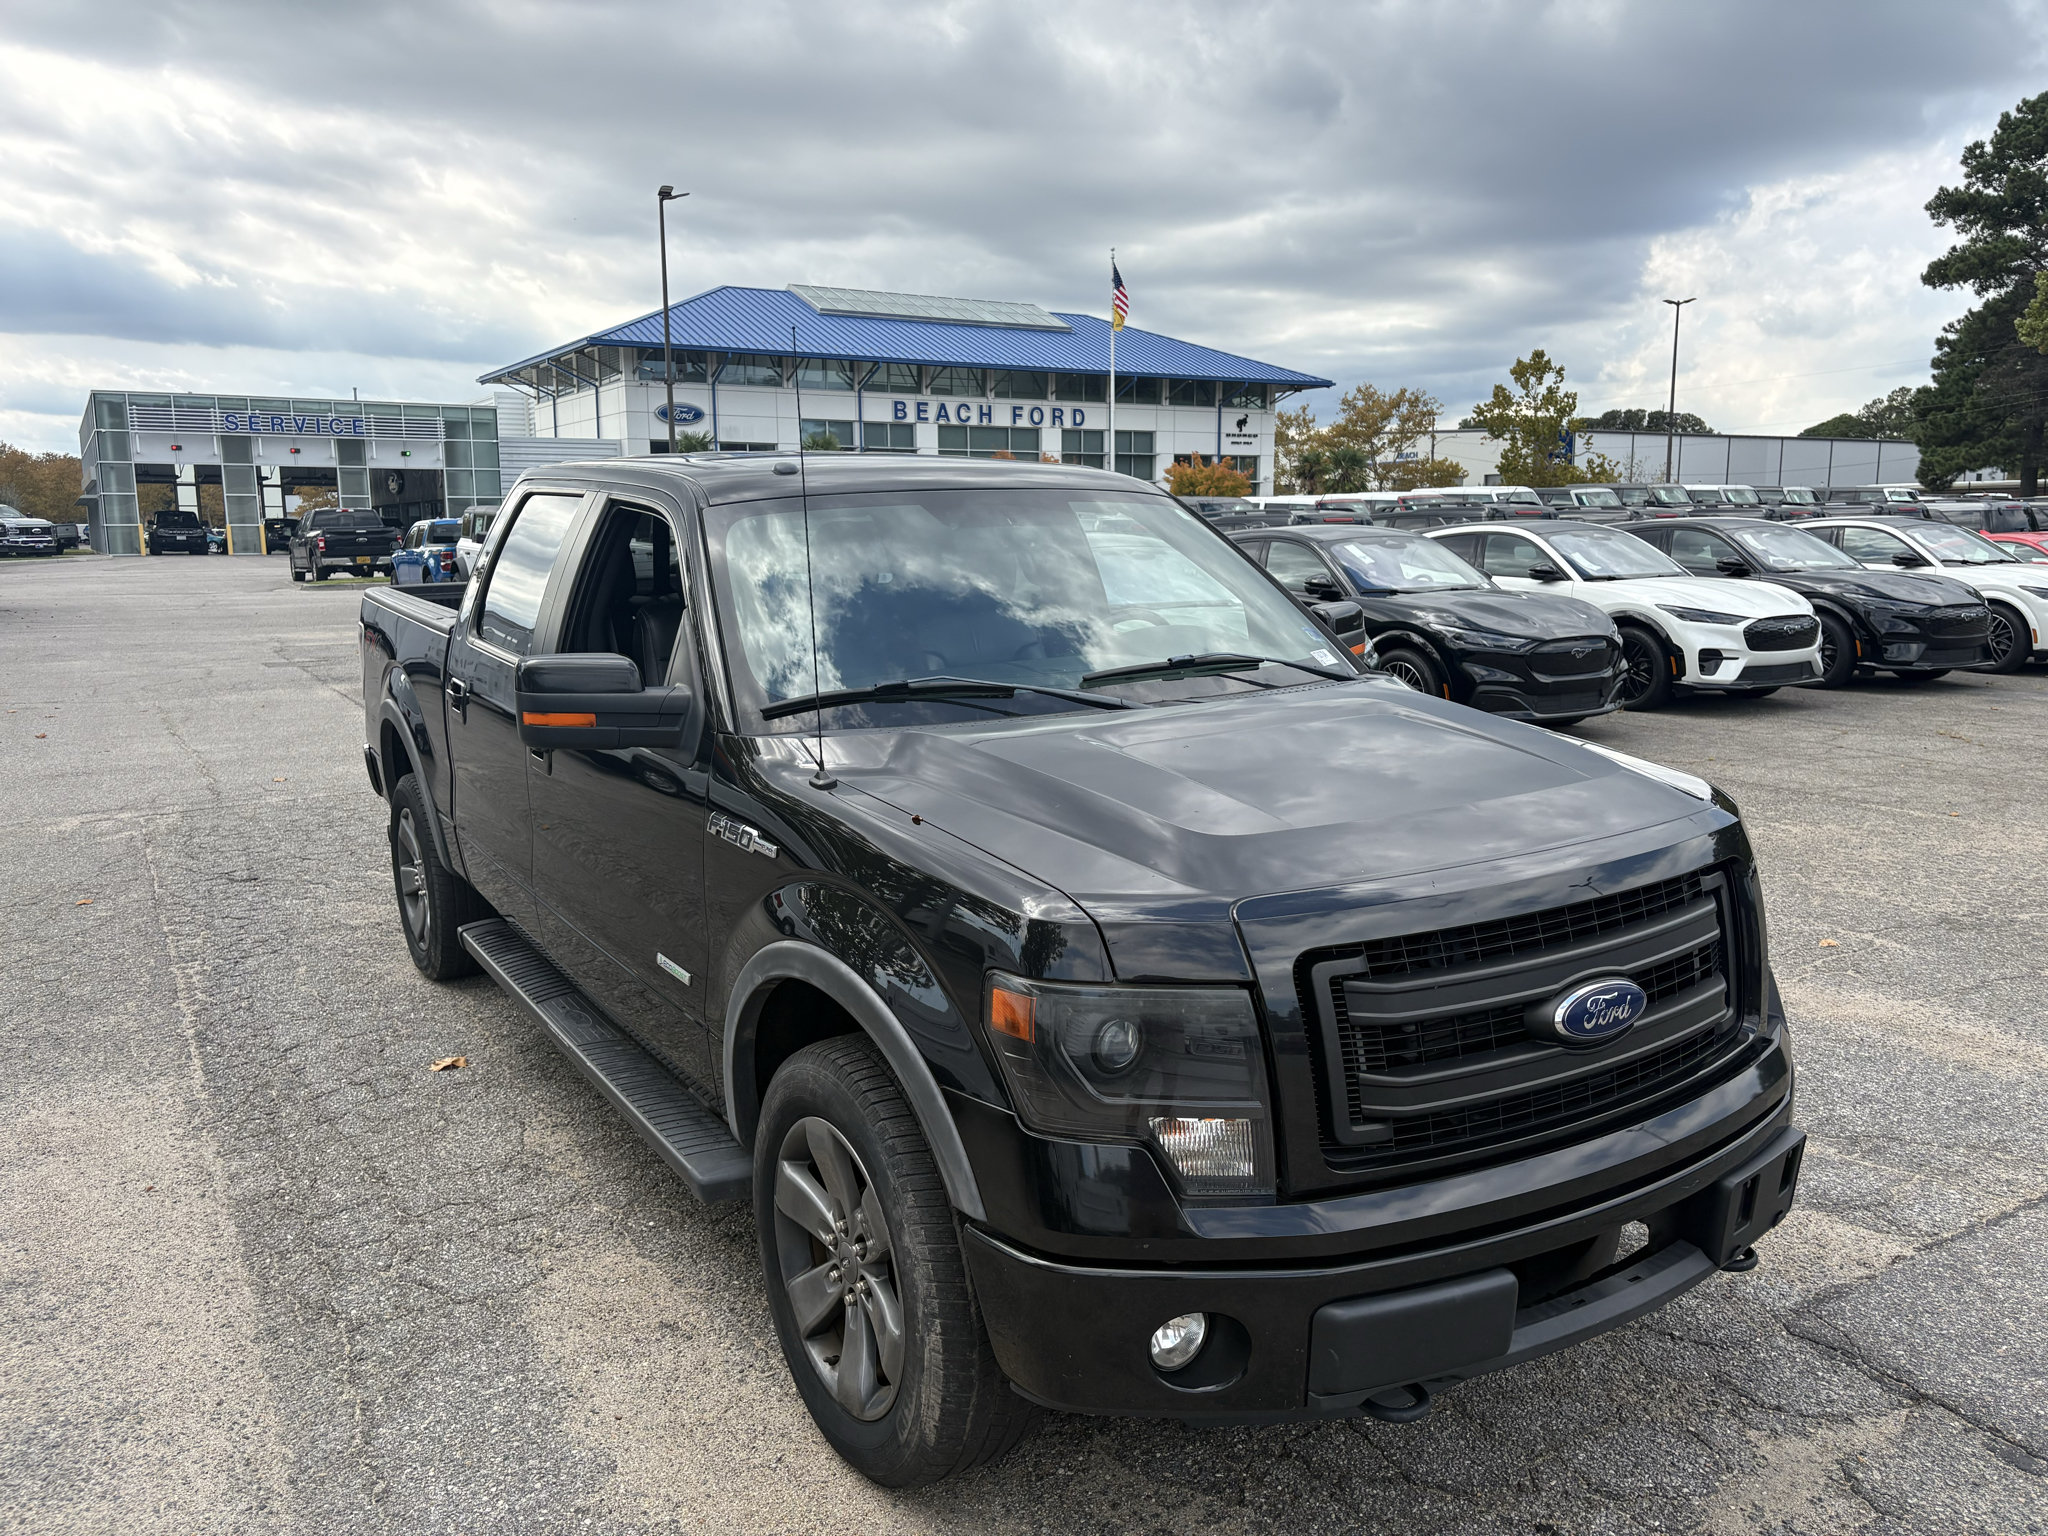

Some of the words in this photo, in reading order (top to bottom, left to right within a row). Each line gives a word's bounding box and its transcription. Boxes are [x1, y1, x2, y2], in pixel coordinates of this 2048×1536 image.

[223, 413, 366, 435] SERVICE
[673, 407, 695, 420] Ford
[893, 400, 993, 424] BEACH
[1011, 405, 1085, 427] FORD
[706, 810, 759, 854] F-150
[1583, 991, 1632, 1030] Ford
